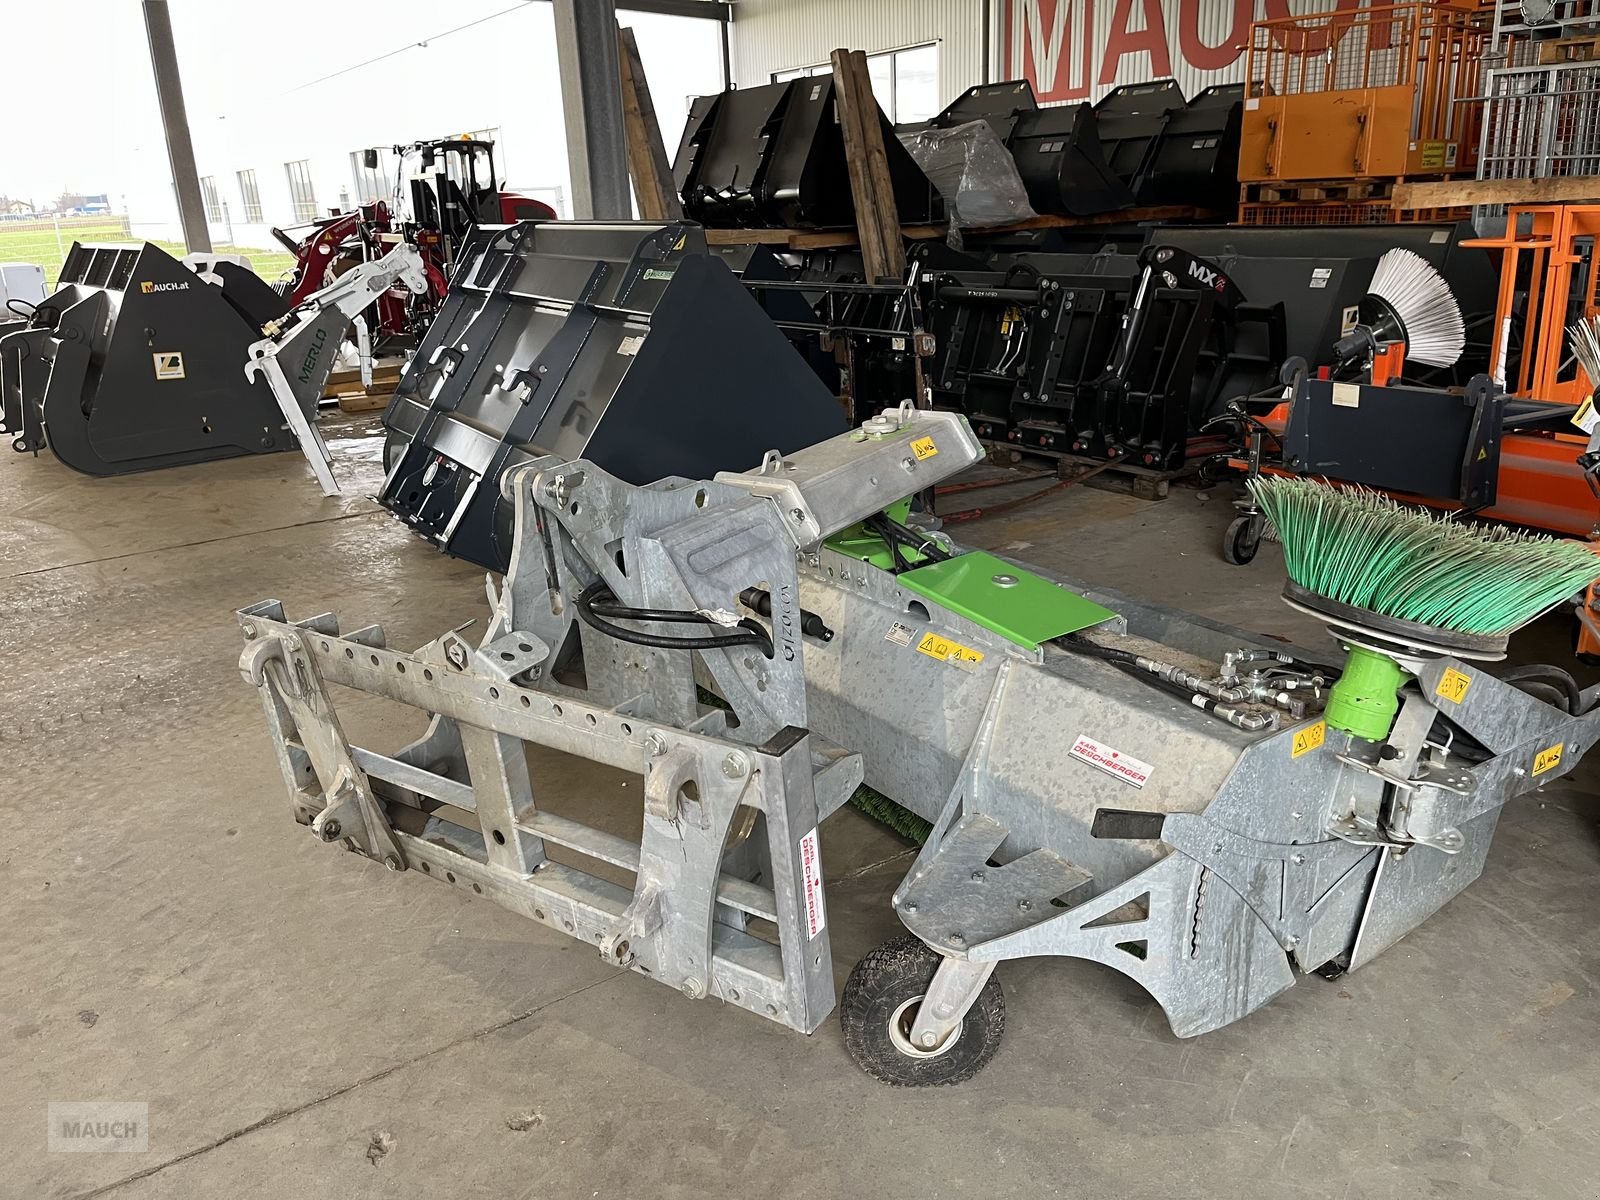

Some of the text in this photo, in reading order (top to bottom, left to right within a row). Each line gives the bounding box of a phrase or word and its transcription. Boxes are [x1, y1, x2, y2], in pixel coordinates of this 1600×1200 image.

[142, 281, 189, 293] MAUCH.at
[1188, 259, 1217, 288] MX
[298, 328, 327, 385] MERLO
[1073, 745, 1147, 782] DESCHBERGER
[1078, 741, 1098, 753] KARL
[802, 838, 817, 935] DESCHBERGER
